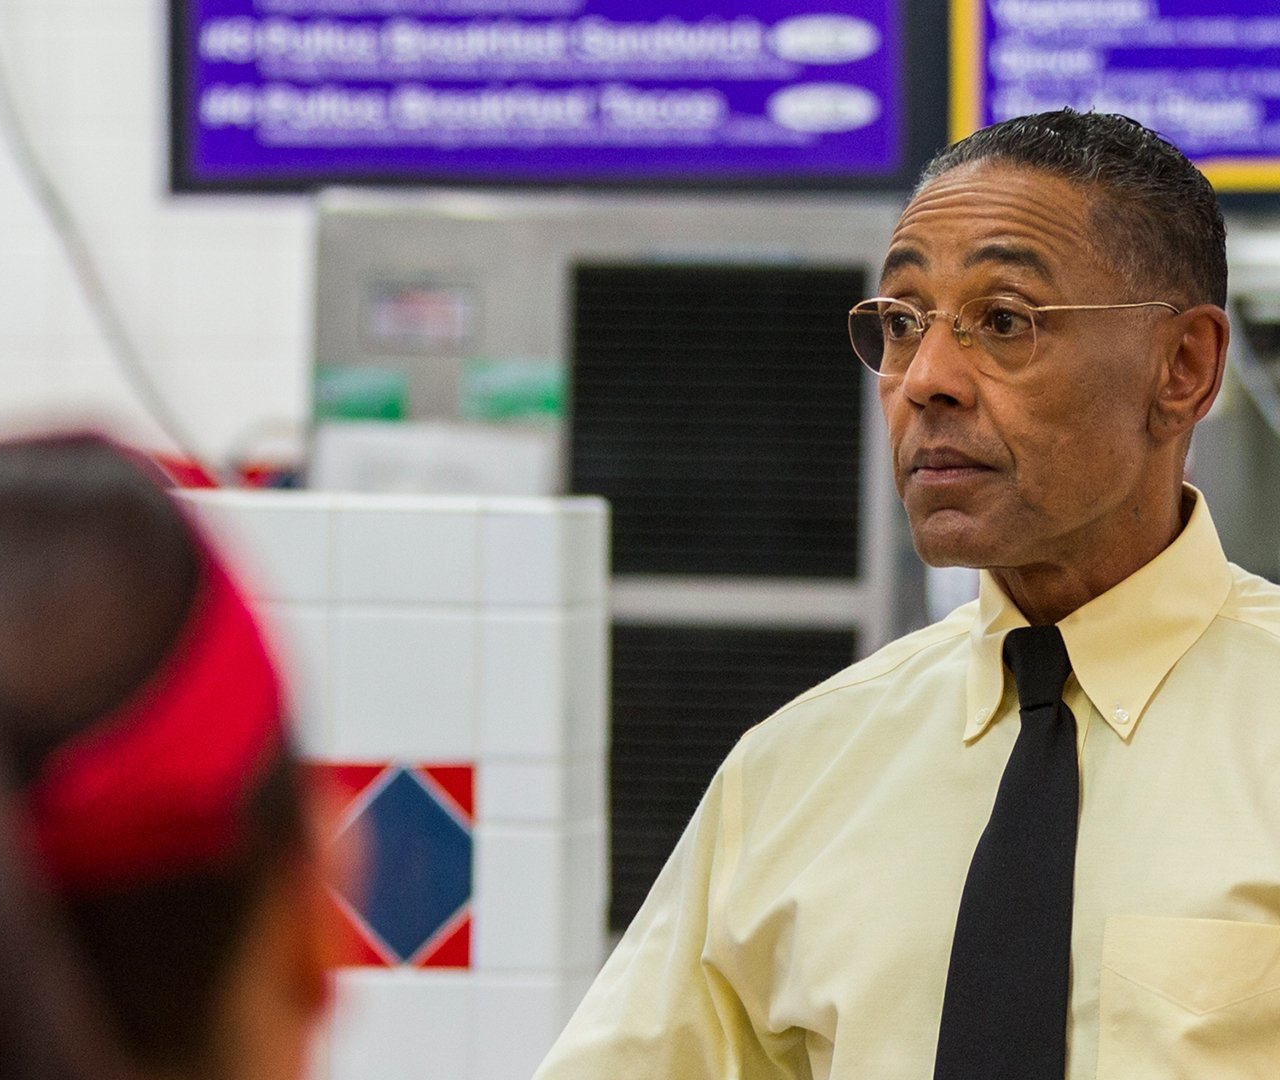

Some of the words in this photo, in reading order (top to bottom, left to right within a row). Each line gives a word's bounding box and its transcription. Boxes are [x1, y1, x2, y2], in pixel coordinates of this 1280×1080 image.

[386, 19, 565, 60] Breakfast
[573, 18, 764, 60] Sandwich
[393, 85, 587, 126] Breakfast
